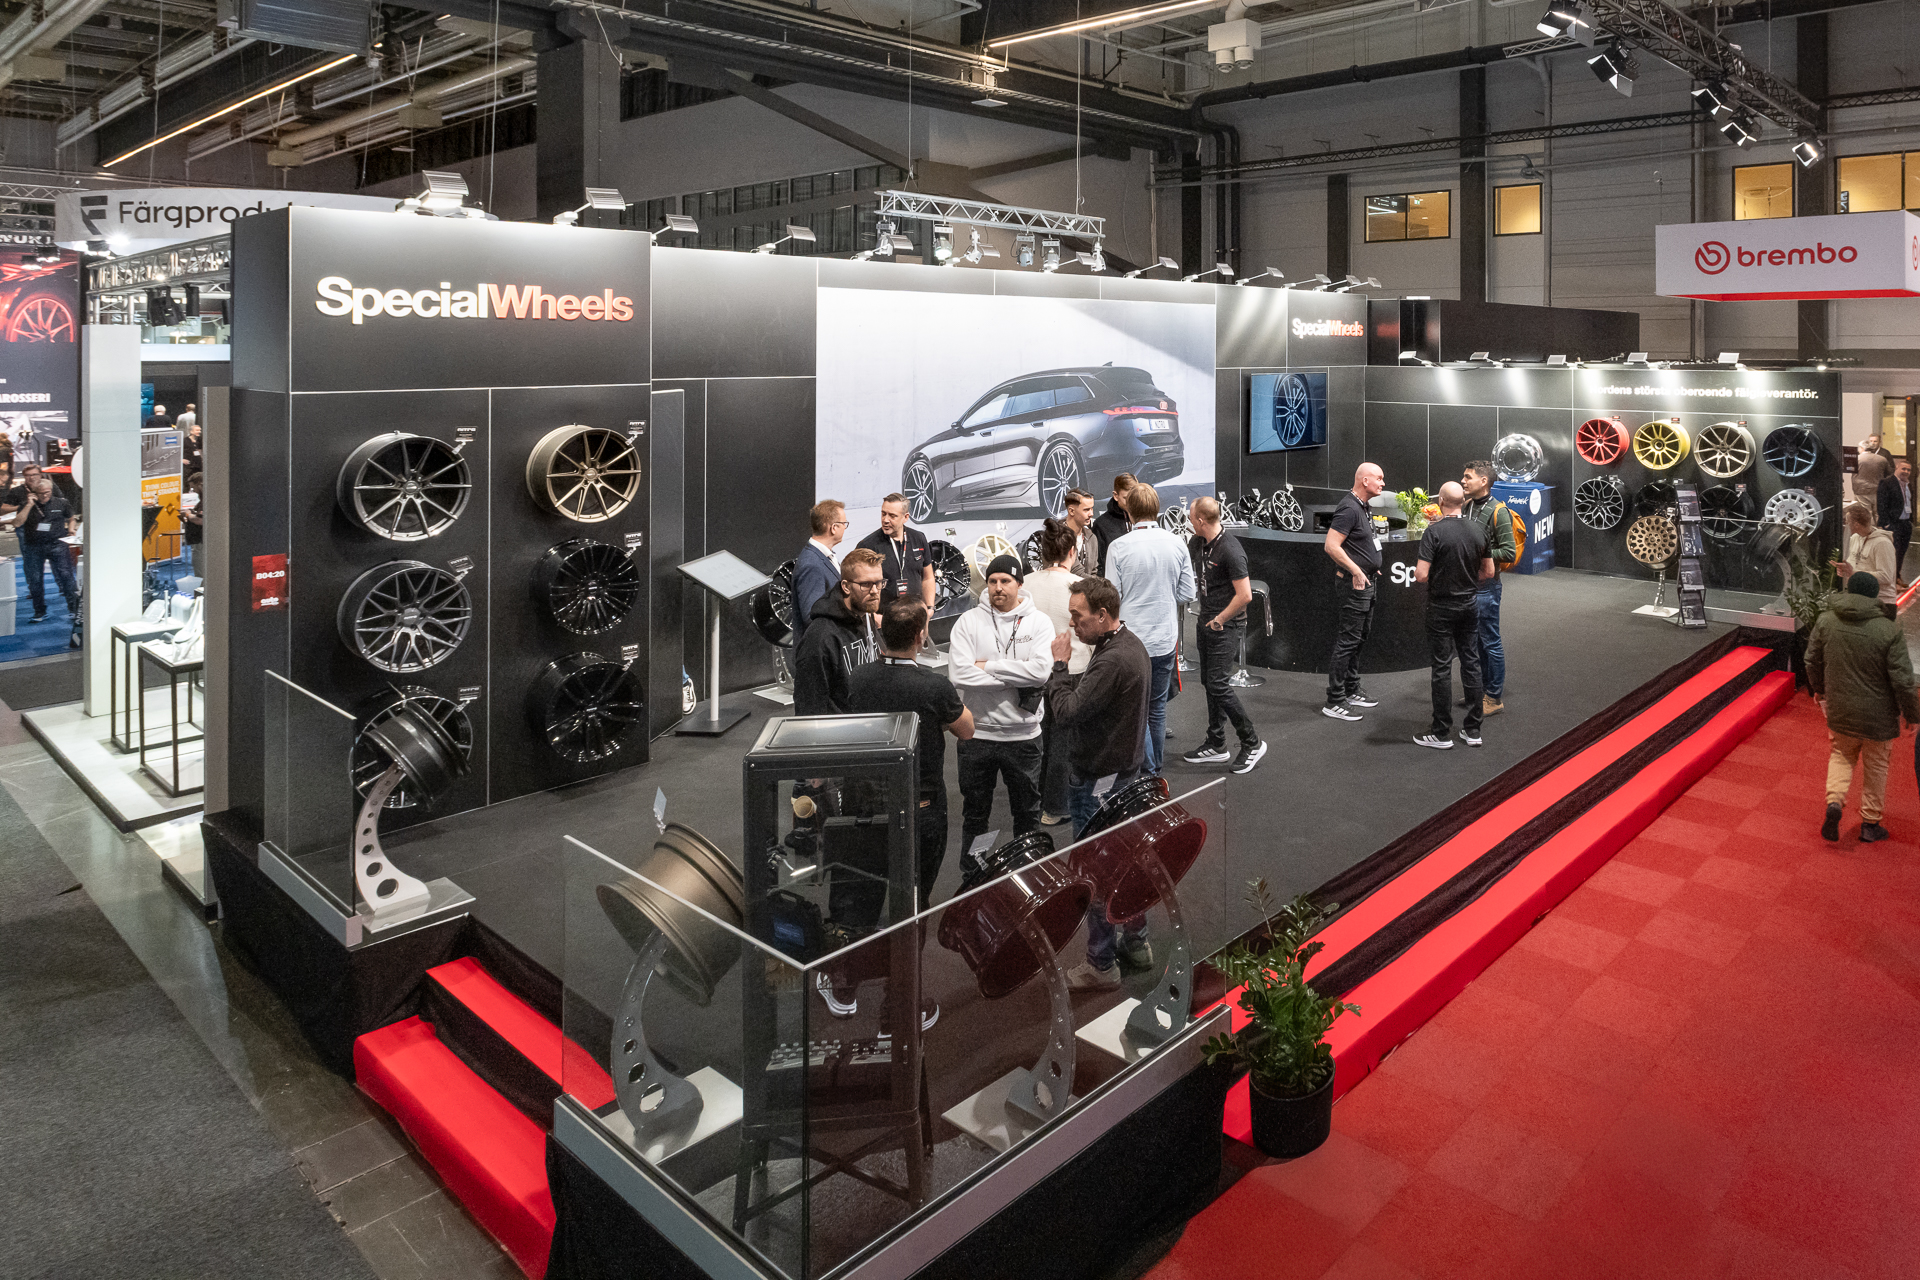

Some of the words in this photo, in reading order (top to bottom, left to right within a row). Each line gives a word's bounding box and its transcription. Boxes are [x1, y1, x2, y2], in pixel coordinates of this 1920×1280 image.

[119, 200, 292, 229] Färgprod
[1737, 242, 1858, 267] brembo
[315, 276, 634, 325] SpecialWheels
[1292, 317, 1364, 339] SpecialWheels
[1674, 387, 1732, 397] oberoende
[1534, 512, 1555, 544] NEW
